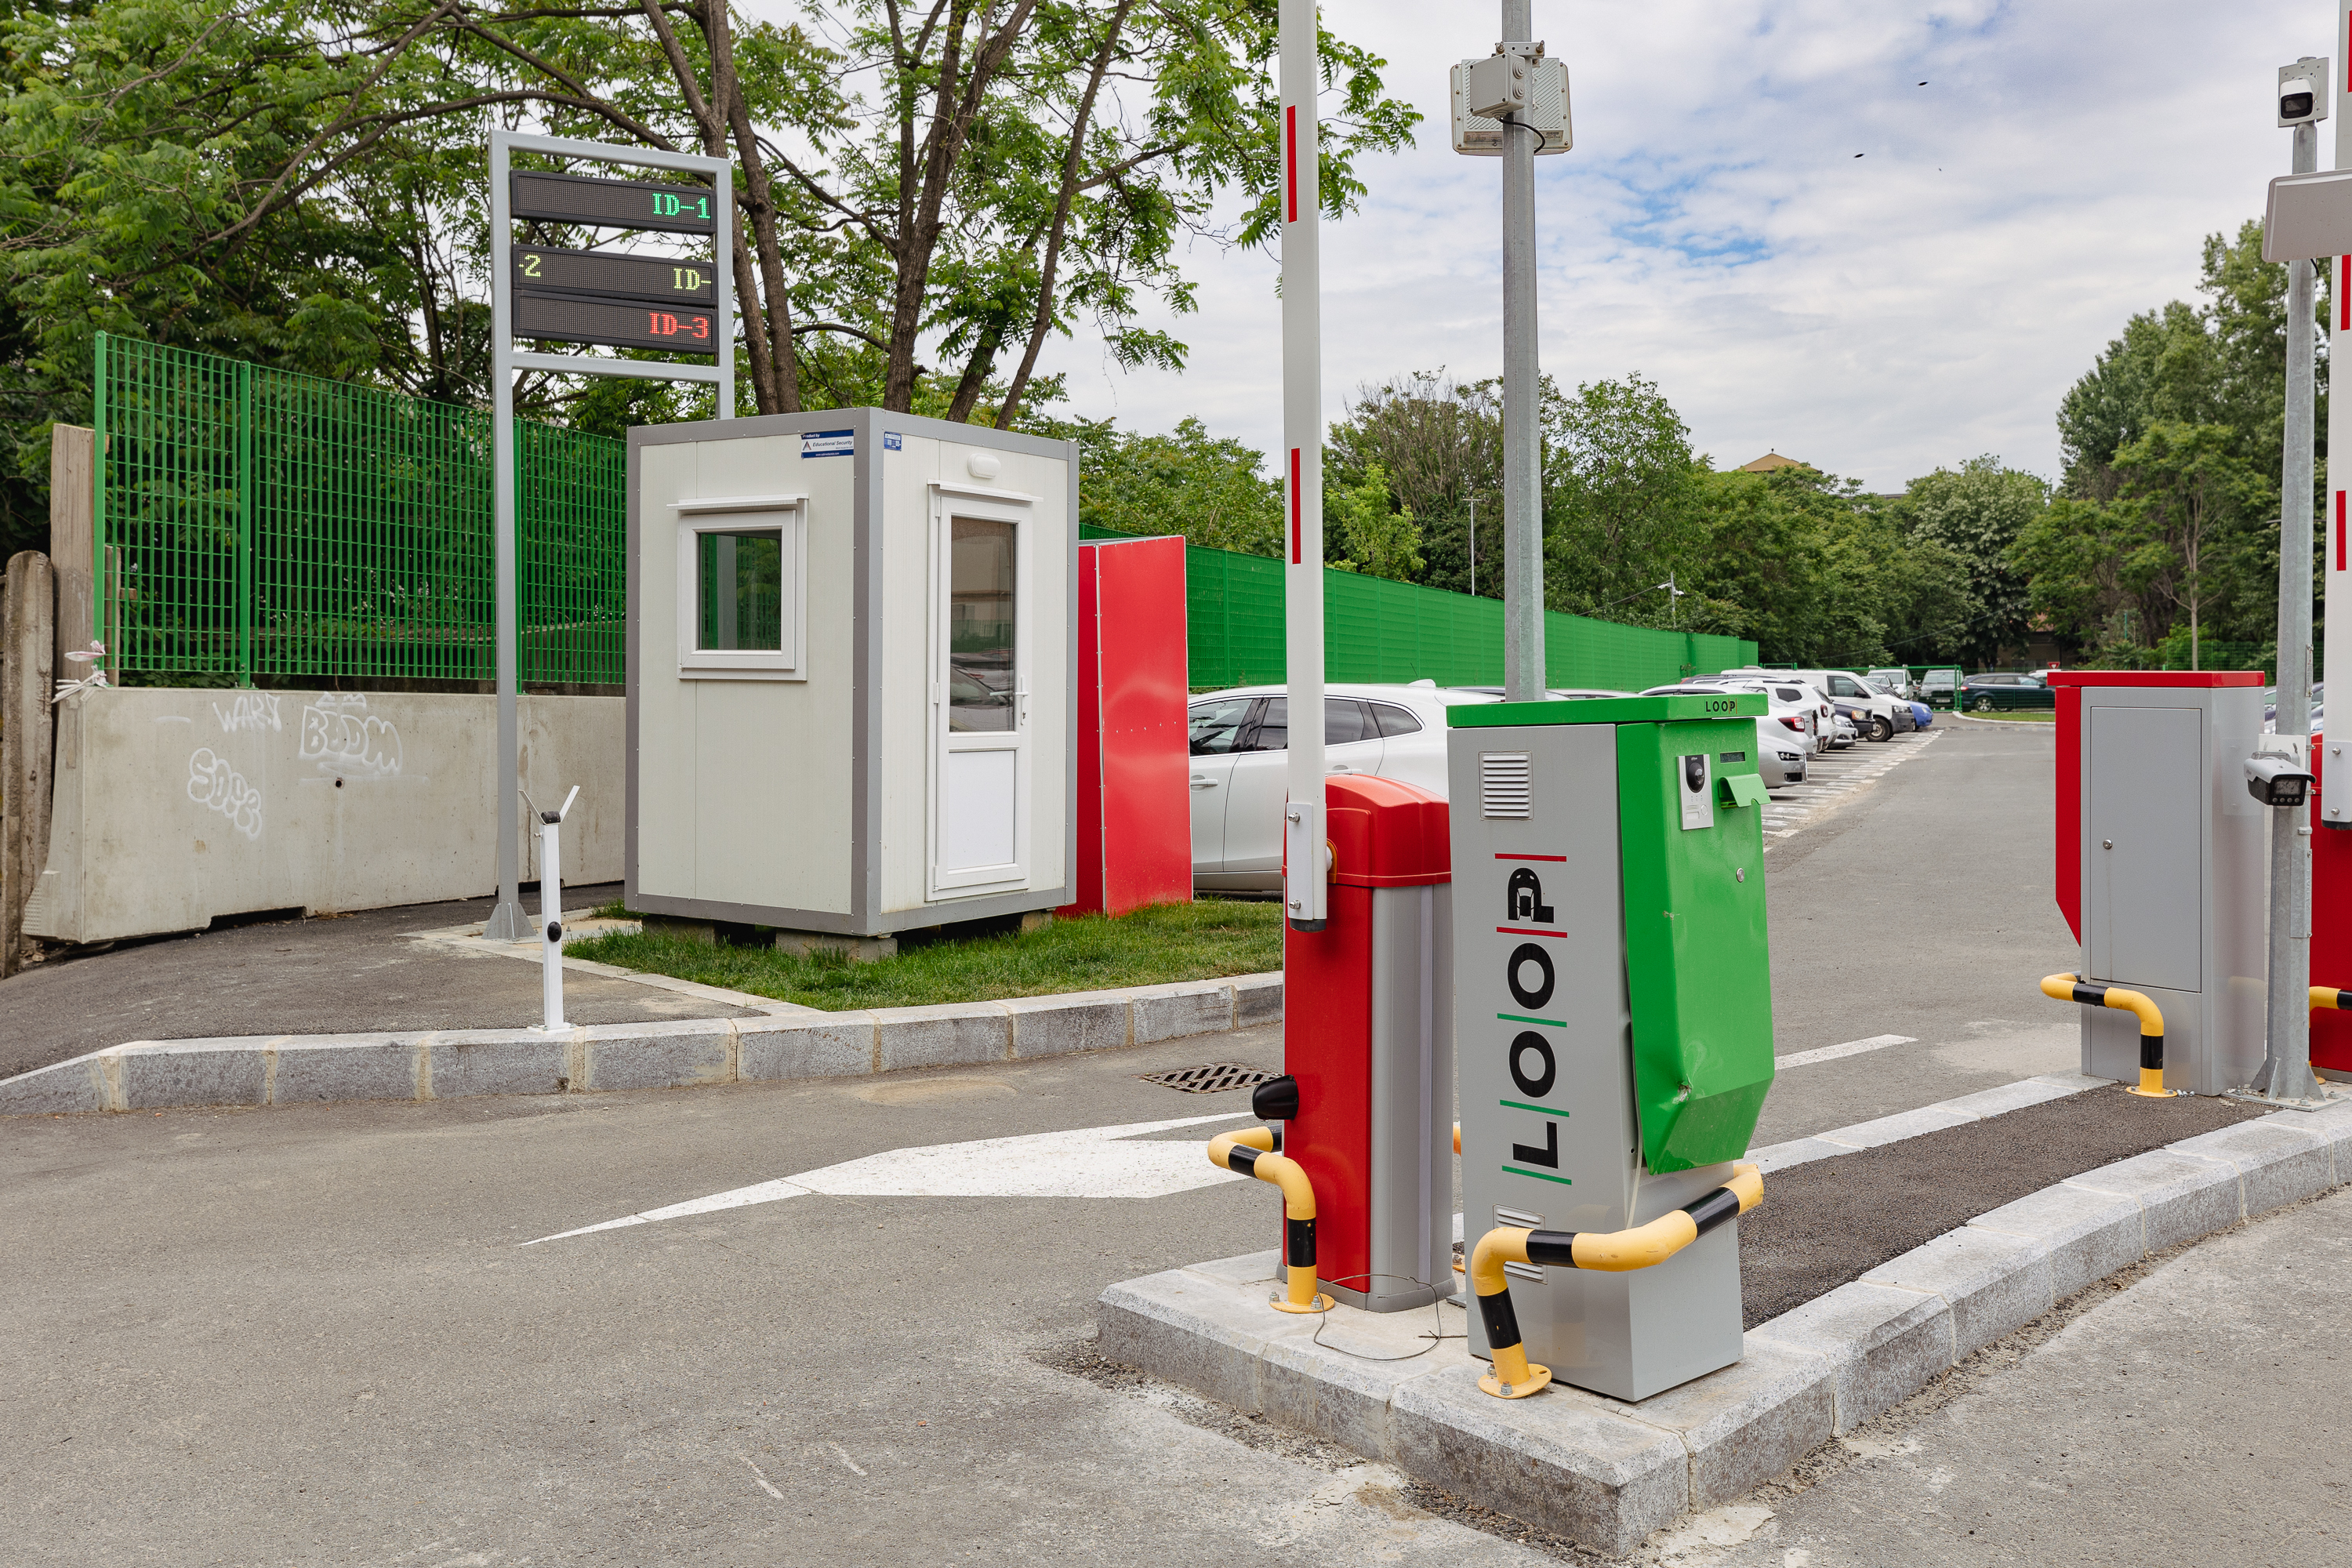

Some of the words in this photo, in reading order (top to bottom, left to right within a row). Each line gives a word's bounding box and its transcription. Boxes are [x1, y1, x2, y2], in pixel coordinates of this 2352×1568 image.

[652, 192, 711, 220] ID-1
[673, 267, 712, 290] ID-
[649, 312, 709, 339] ID-3
[1705, 700, 1736, 713] LOOP
[1507, 867, 1559, 1170] LOOP
